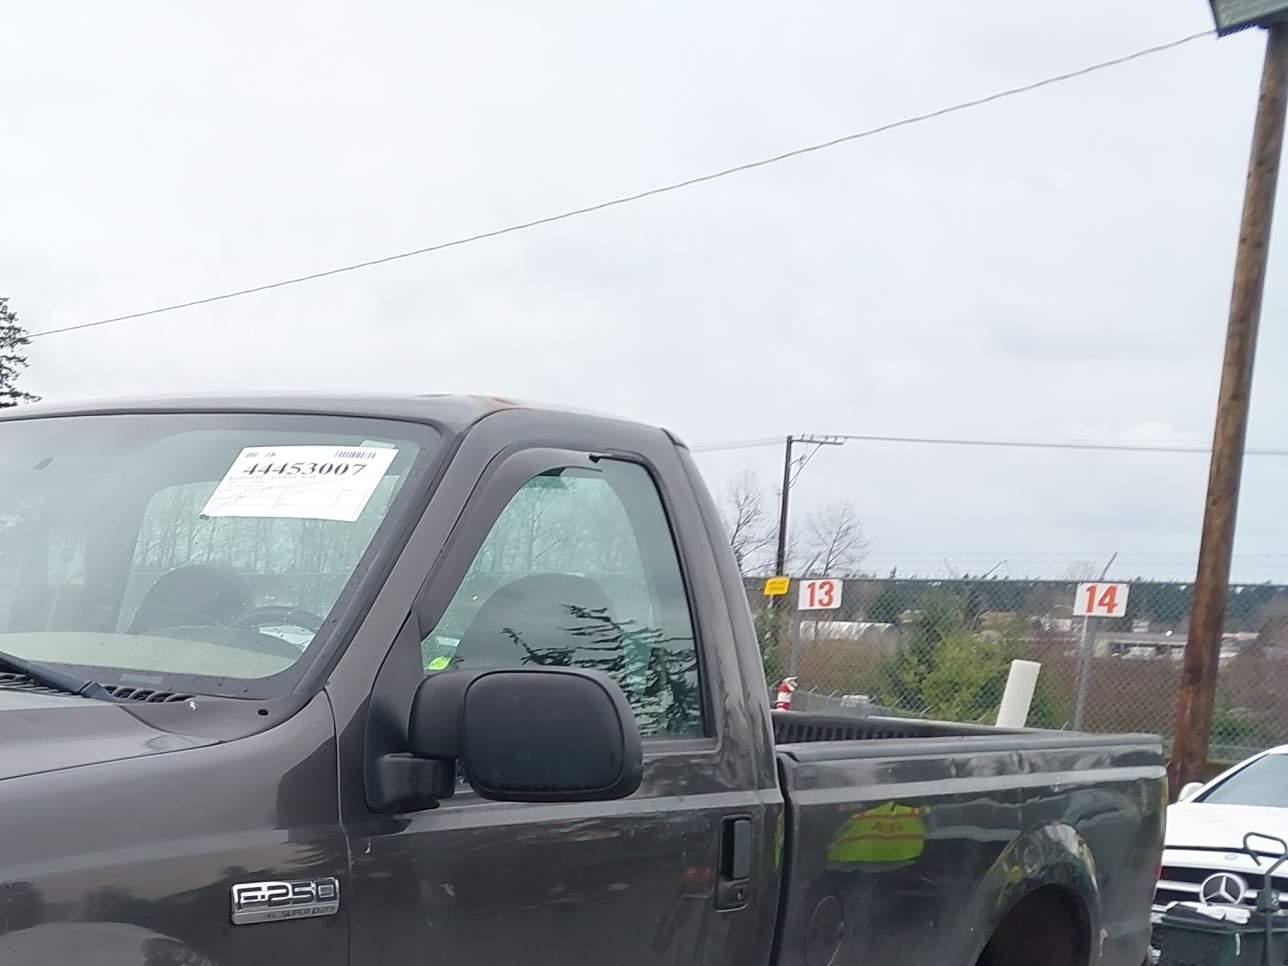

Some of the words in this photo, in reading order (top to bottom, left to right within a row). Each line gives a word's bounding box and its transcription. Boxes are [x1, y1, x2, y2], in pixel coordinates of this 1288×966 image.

[243, 462, 368, 476] 44453007
[807, 580, 834, 608] 13
[1084, 584, 1118, 614] 14
